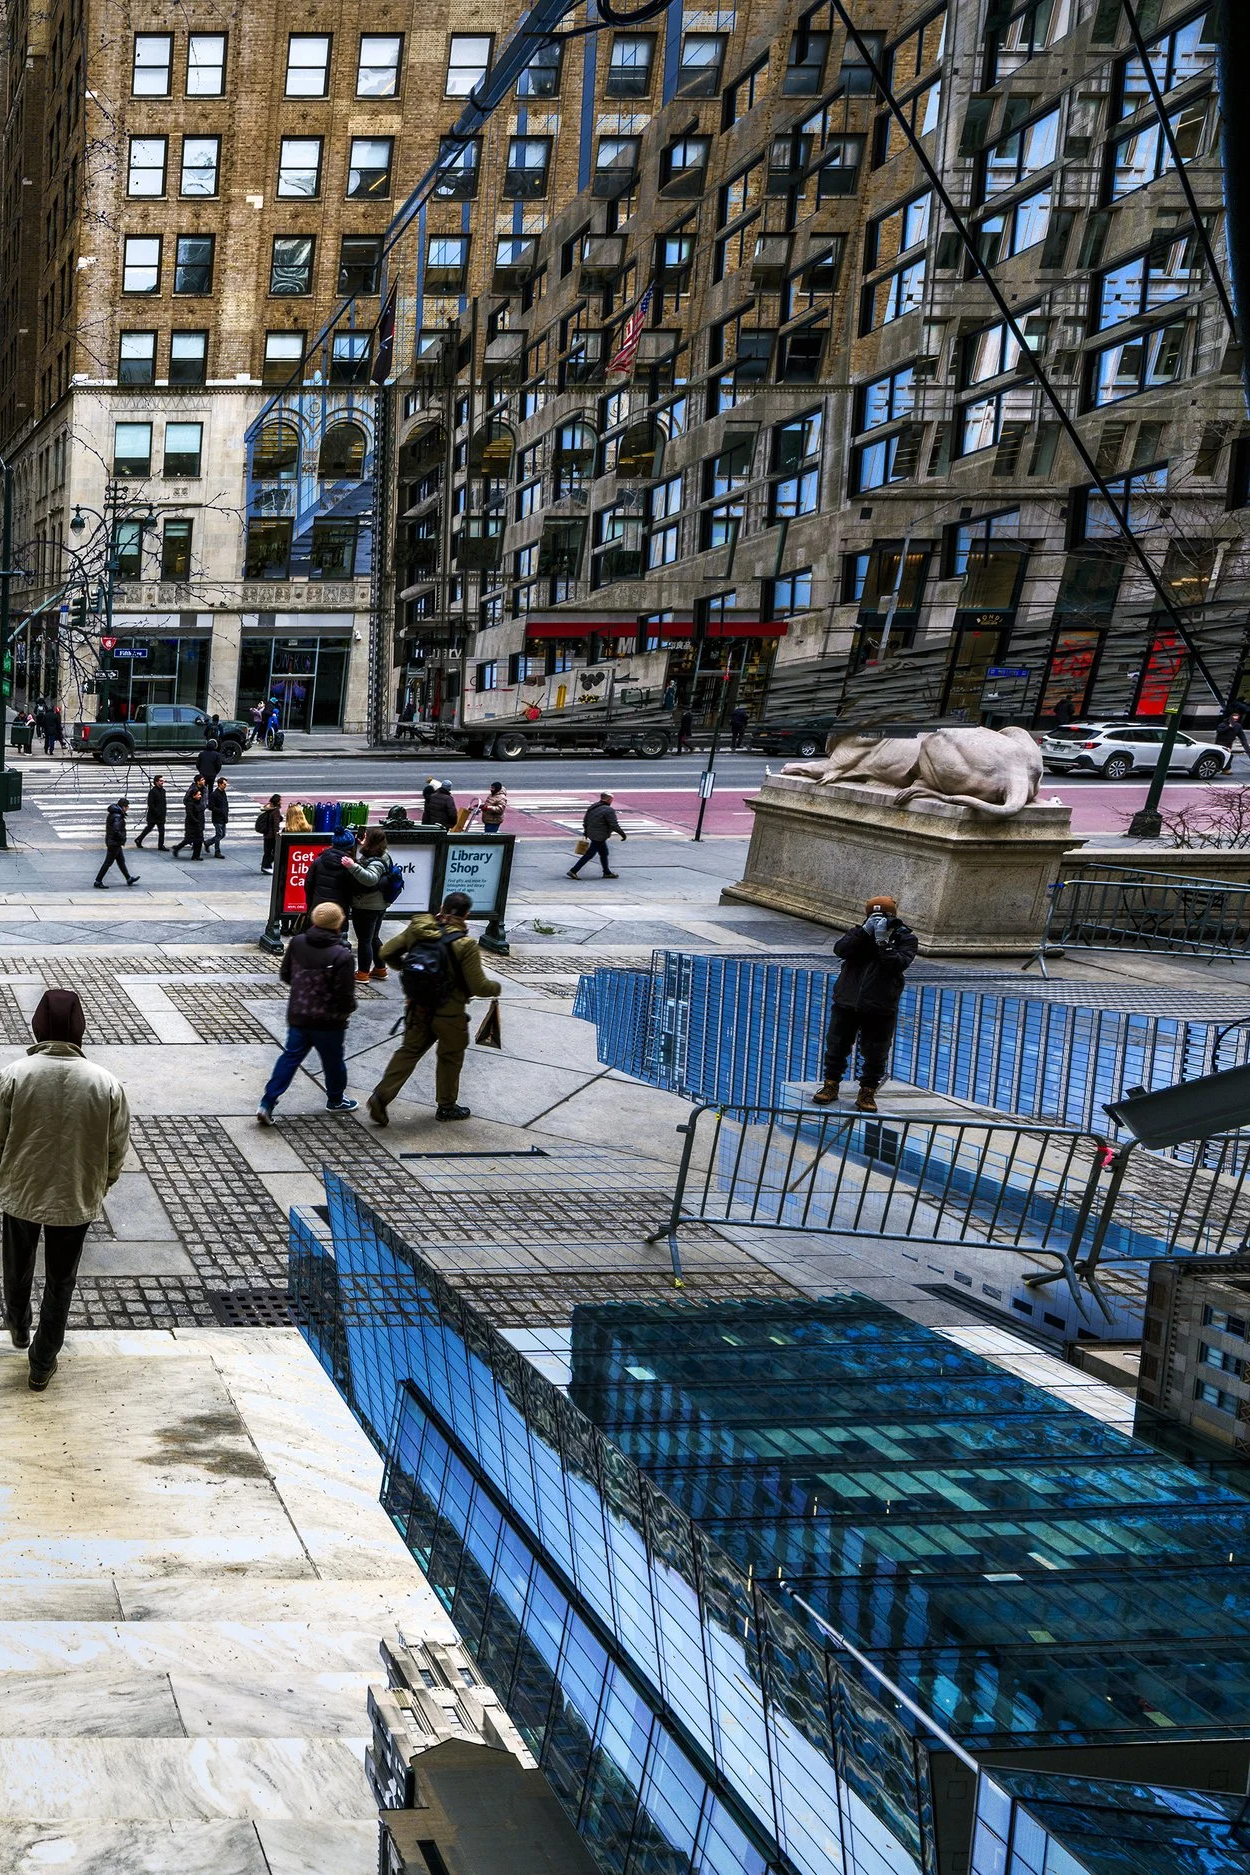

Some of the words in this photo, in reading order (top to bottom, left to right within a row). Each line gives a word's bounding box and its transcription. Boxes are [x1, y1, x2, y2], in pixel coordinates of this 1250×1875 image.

[292, 851, 314, 862] Get
[451, 850, 493, 864] Library
[450, 863, 479, 876] Shop
[290, 876, 305, 886] Ca
